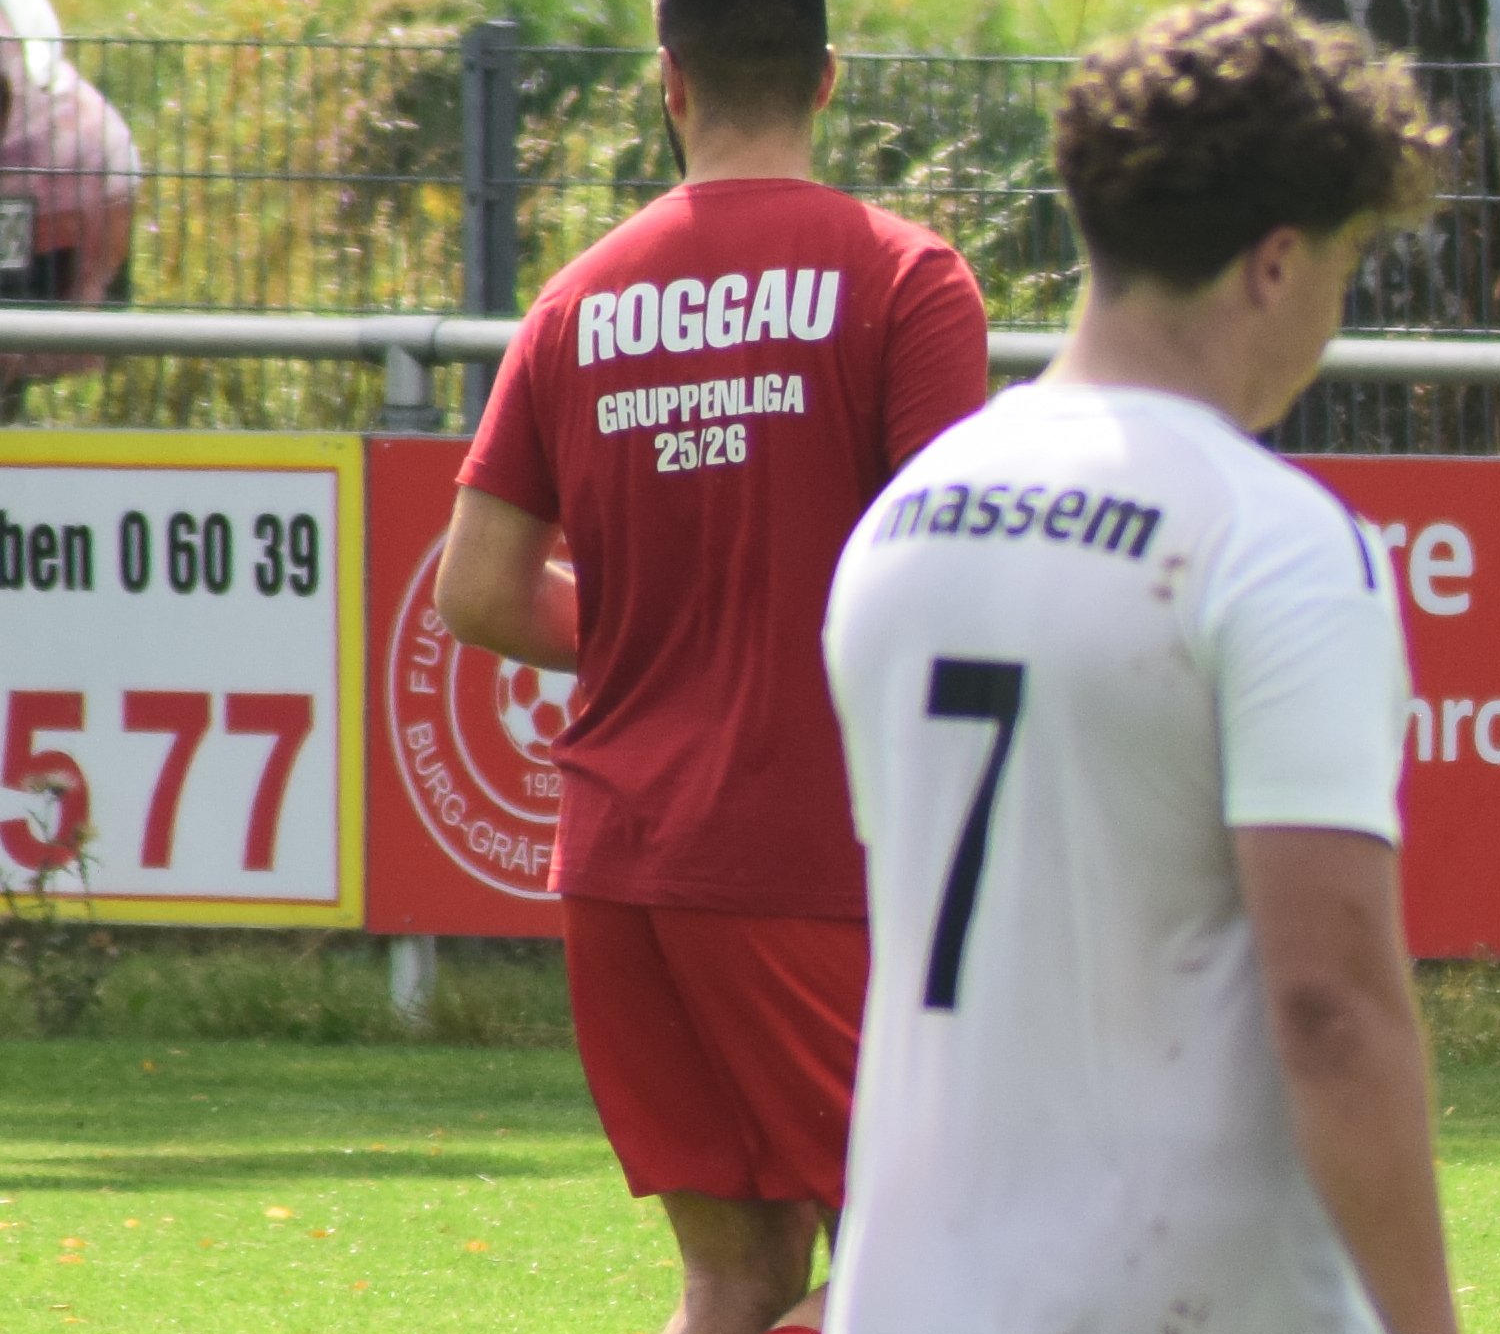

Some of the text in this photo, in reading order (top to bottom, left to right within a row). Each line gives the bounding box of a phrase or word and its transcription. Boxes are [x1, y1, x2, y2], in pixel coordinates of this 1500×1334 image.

[577, 269, 840, 367] ROGGAU
[597, 375, 805, 435] GRUPPENLIGA
[654, 424, 747, 473] 25/26
[120, 510, 151, 595] 0
[168, 511, 234, 595] 60
[254, 512, 320, 598] 39
[121, 690, 316, 872] 77
[407, 722, 553, 876] BURG-GRÄF
[522, 772, 562, 798] 192
[925, 656, 1025, 1012] 7
